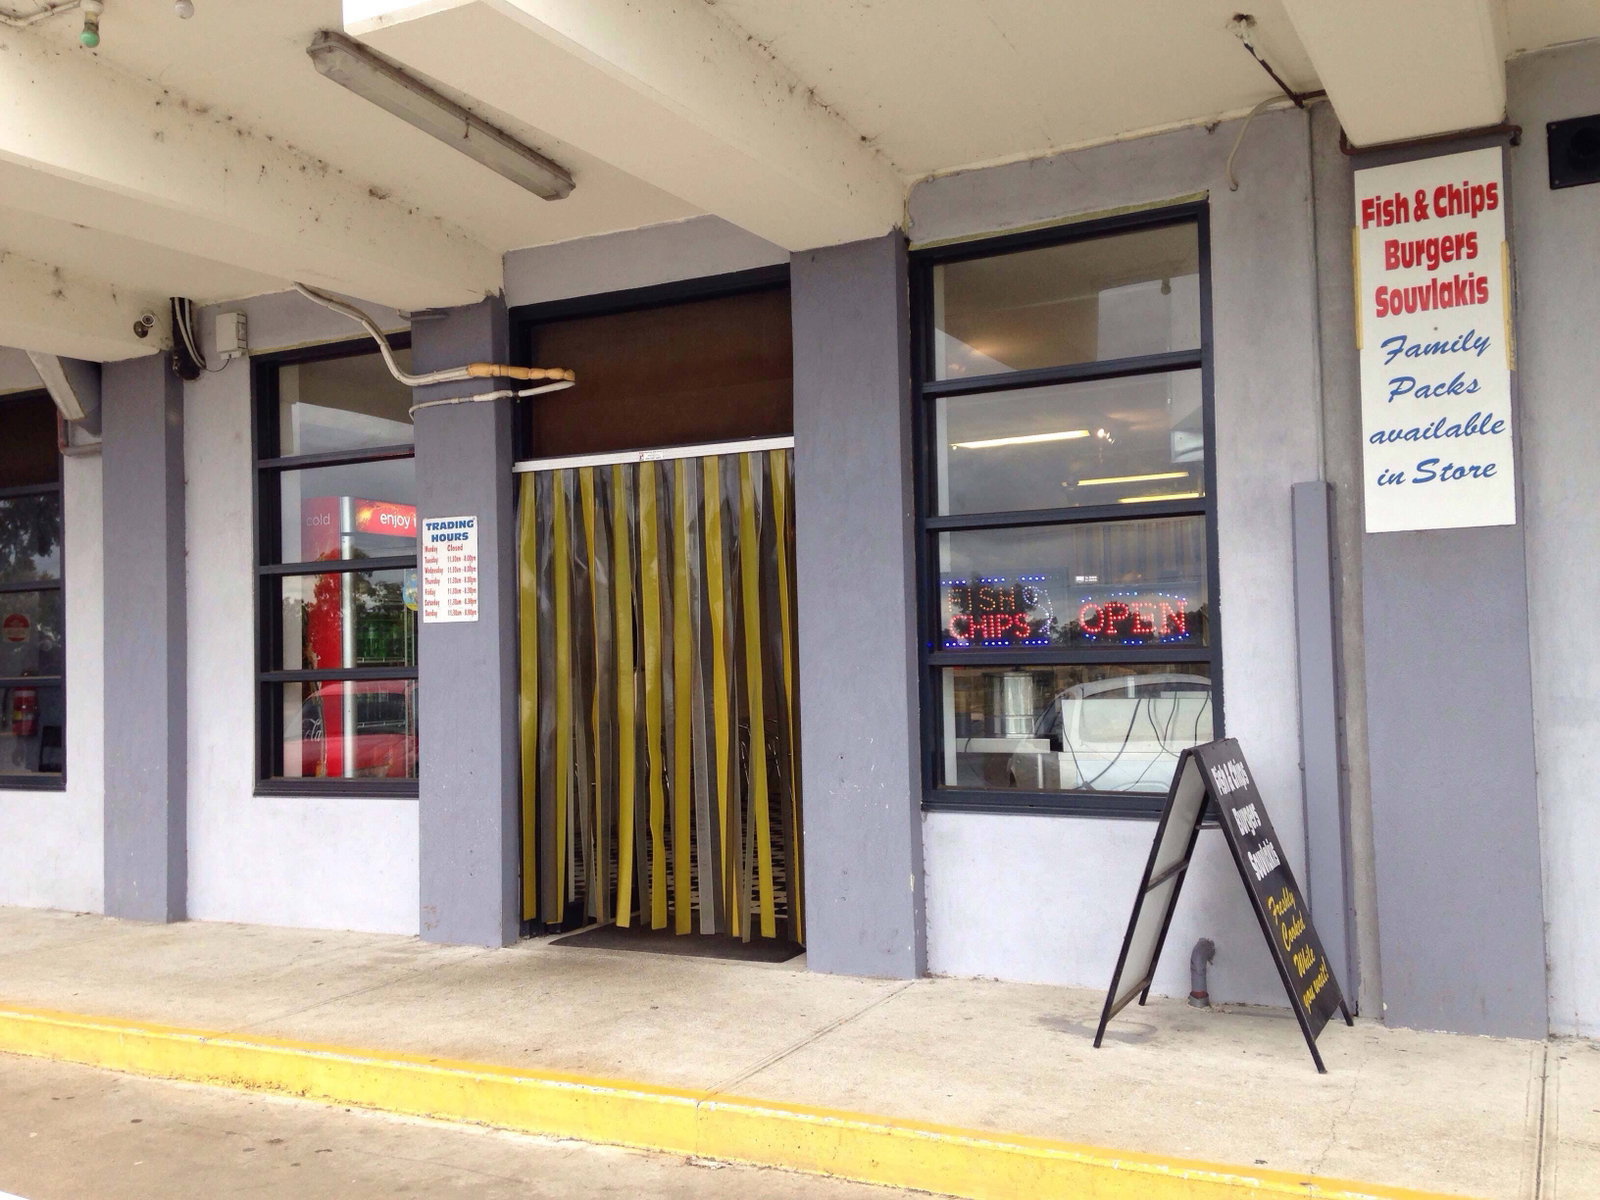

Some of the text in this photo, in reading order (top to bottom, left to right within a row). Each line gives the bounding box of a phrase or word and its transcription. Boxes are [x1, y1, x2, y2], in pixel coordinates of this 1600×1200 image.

[1361, 181, 1499, 229] Fish & Chips
[1384, 231, 1478, 271] Burgers
[1375, 272, 1489, 318] Souvlakis
[1380, 328, 1491, 366] Family
[1388, 371, 1480, 403] Packs
[1369, 412, 1505, 445] available
[1377, 458, 1497, 487] in Store
[306, 513, 331, 526] cold
[380, 513, 411, 528] enjoy
[426, 520, 474, 531] TRADING
[431, 532, 469, 542] HOURS
[948, 586, 1016, 611] FISH
[950, 613, 1031, 639] CHIPS
[1079, 601, 1188, 634] OPEN
[1211, 764, 1231, 796] Fish
[1227, 759, 1250, 791] Chips
[1232, 803, 1262, 837] Burgers
[1247, 838, 1281, 882] Souvlakis
[1267, 886, 1297, 926] Freshly
[1281, 909, 1306, 952] Cooked
[1293, 943, 1316, 978] While
[1303, 984, 1316, 1015] you
